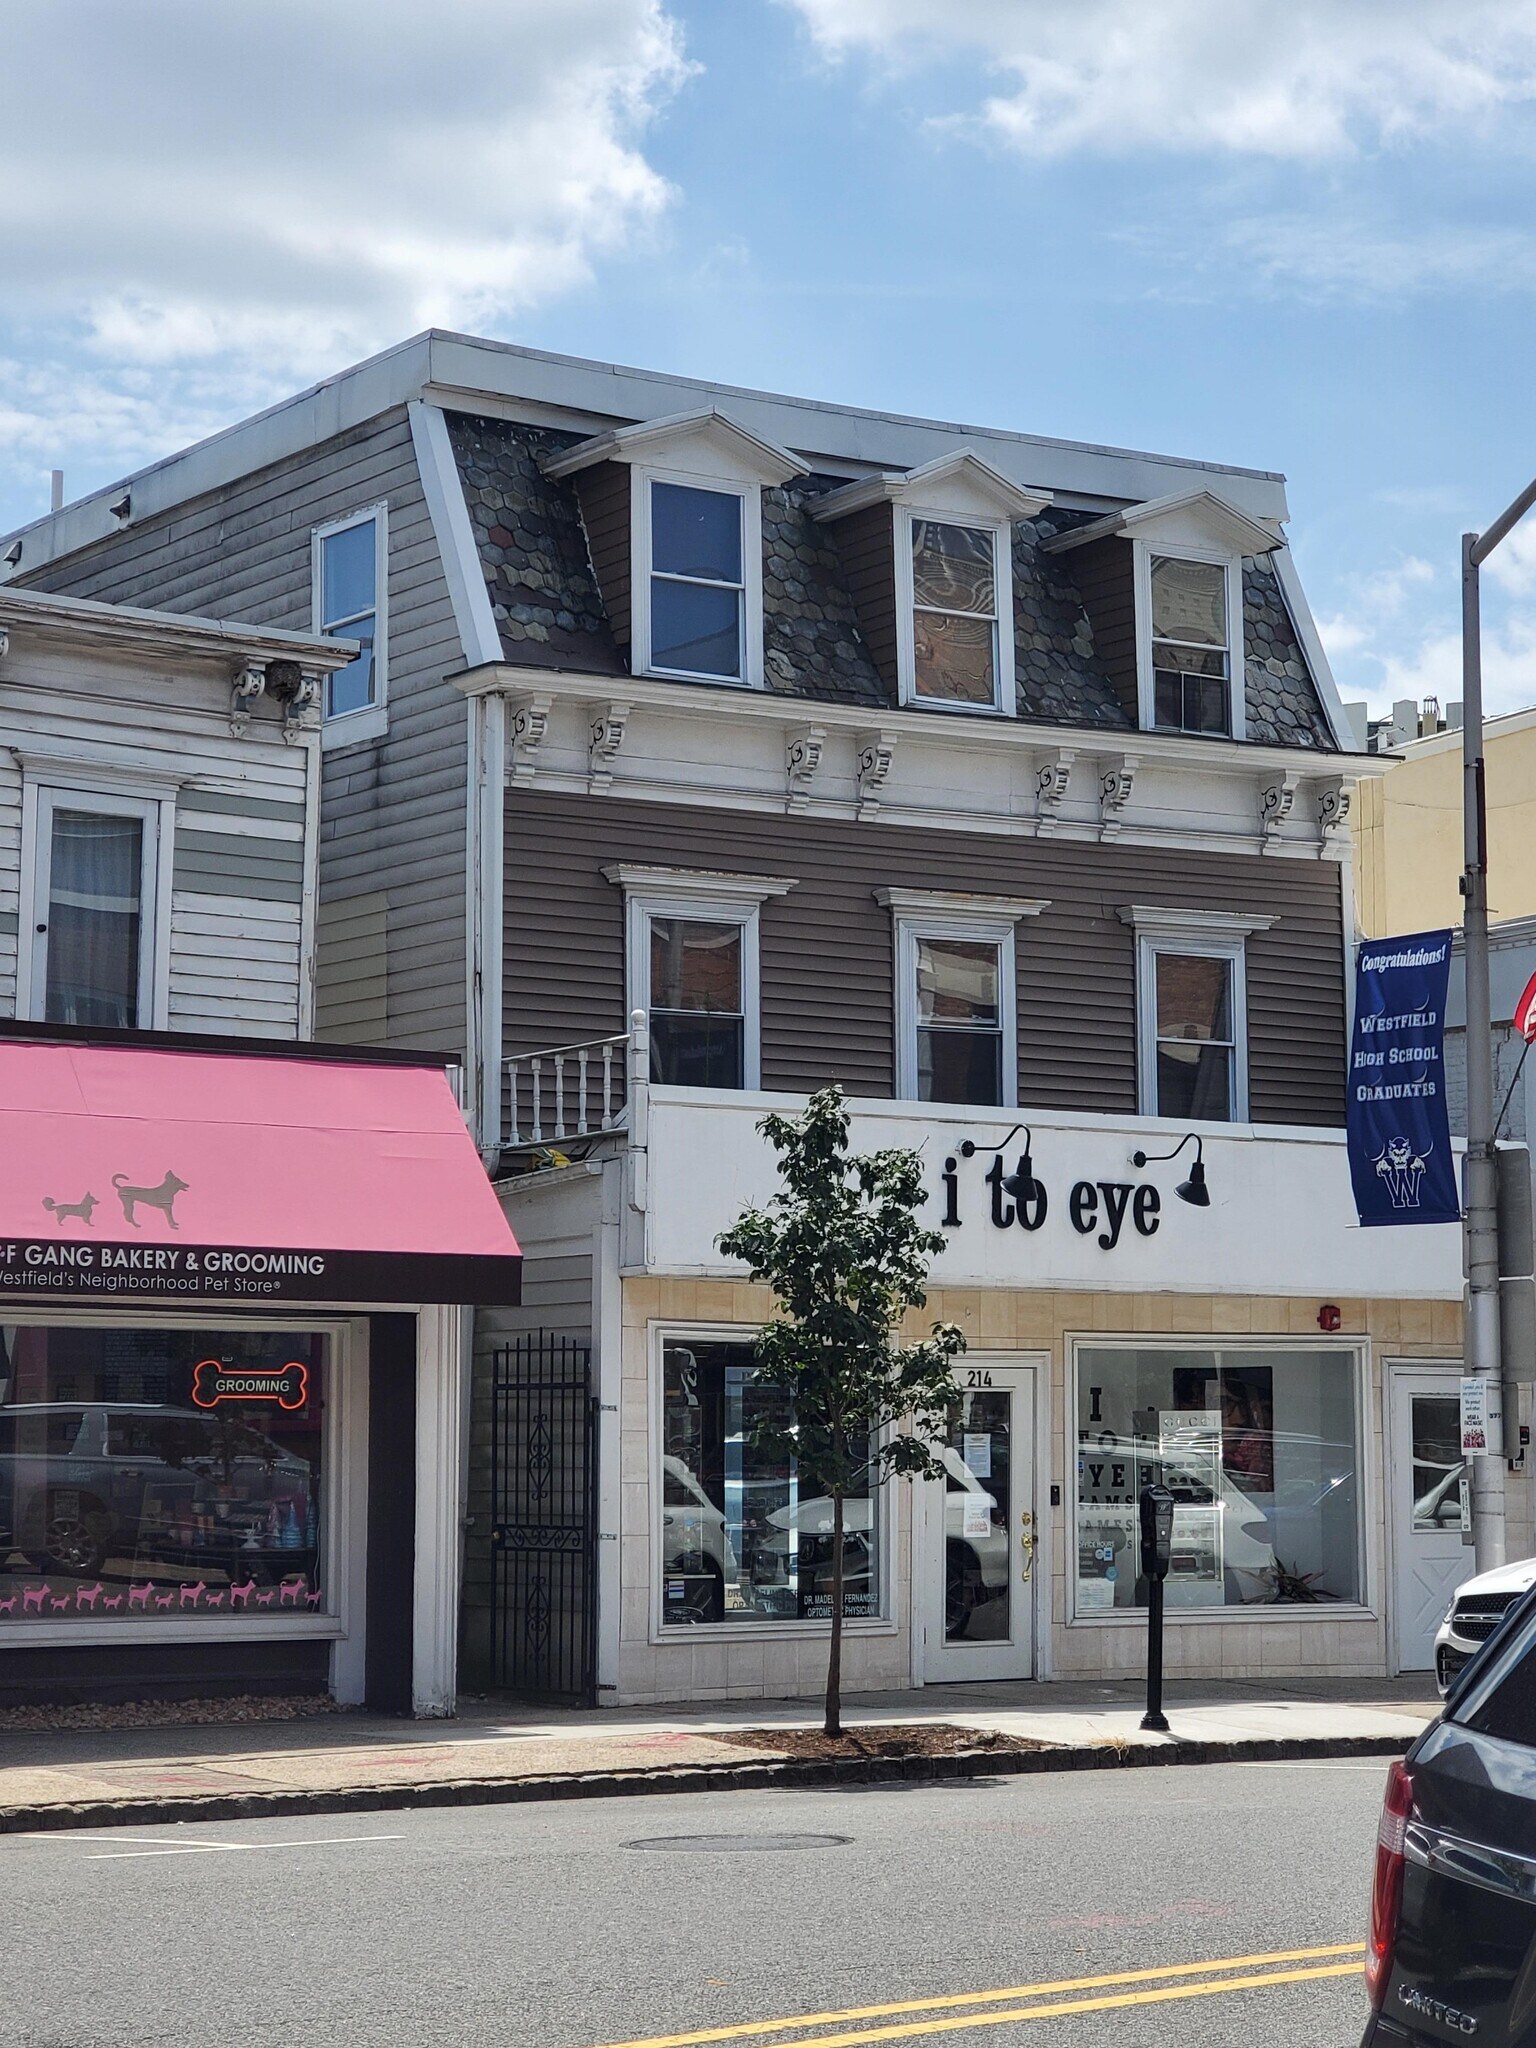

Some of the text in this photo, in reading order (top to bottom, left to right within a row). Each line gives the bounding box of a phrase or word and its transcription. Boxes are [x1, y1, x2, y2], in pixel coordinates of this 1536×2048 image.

[1361, 943, 1447, 973] Congratulations!
[1360, 1011, 1437, 1034] WESTFIELD
[1354, 1046, 1439, 1069] HIGH SCHOOL
[1356, 1081, 1436, 1102] GRADUATES
[941, 1154, 1161, 1250] i to eye
[24, 1245, 94, 1266] GANG
[101, 1248, 179, 1270] BAKERY
[185, 1252, 199, 1271] &
[203, 1251, 325, 1275] GROOMING
[80, 1273, 199, 1291] Neighborhood
[204, 1276, 229, 1291] Pet
[215, 1379, 290, 1392] GROOMING
[968, 1370, 992, 1387] 214
[1164, 1416, 1217, 1428] GUCCI
[1088, 1464, 1125, 1487] YE
[844, 1593, 878, 1604] FERNANDEZ
[844, 1605, 875, 1616] PHYSICIAN
